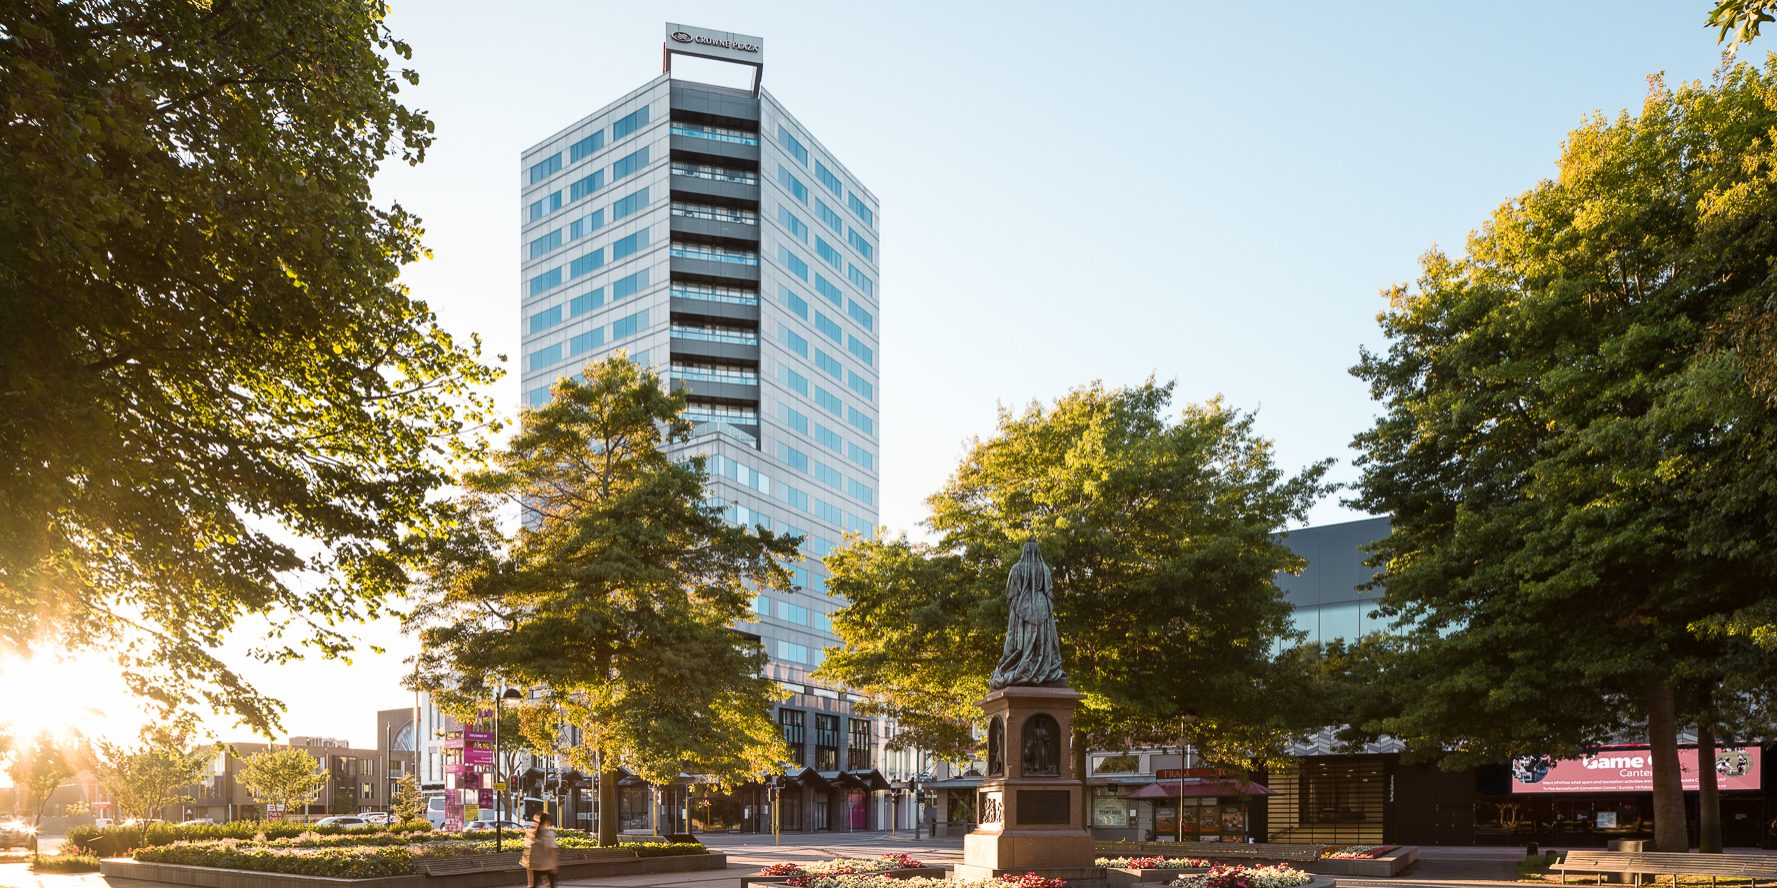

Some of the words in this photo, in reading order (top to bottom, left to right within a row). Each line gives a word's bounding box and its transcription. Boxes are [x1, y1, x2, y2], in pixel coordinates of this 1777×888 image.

[695, 34, 730, 49] CROWNE
[732, 41, 759, 53] PLAZA
[1583, 755, 1644, 769] Game
